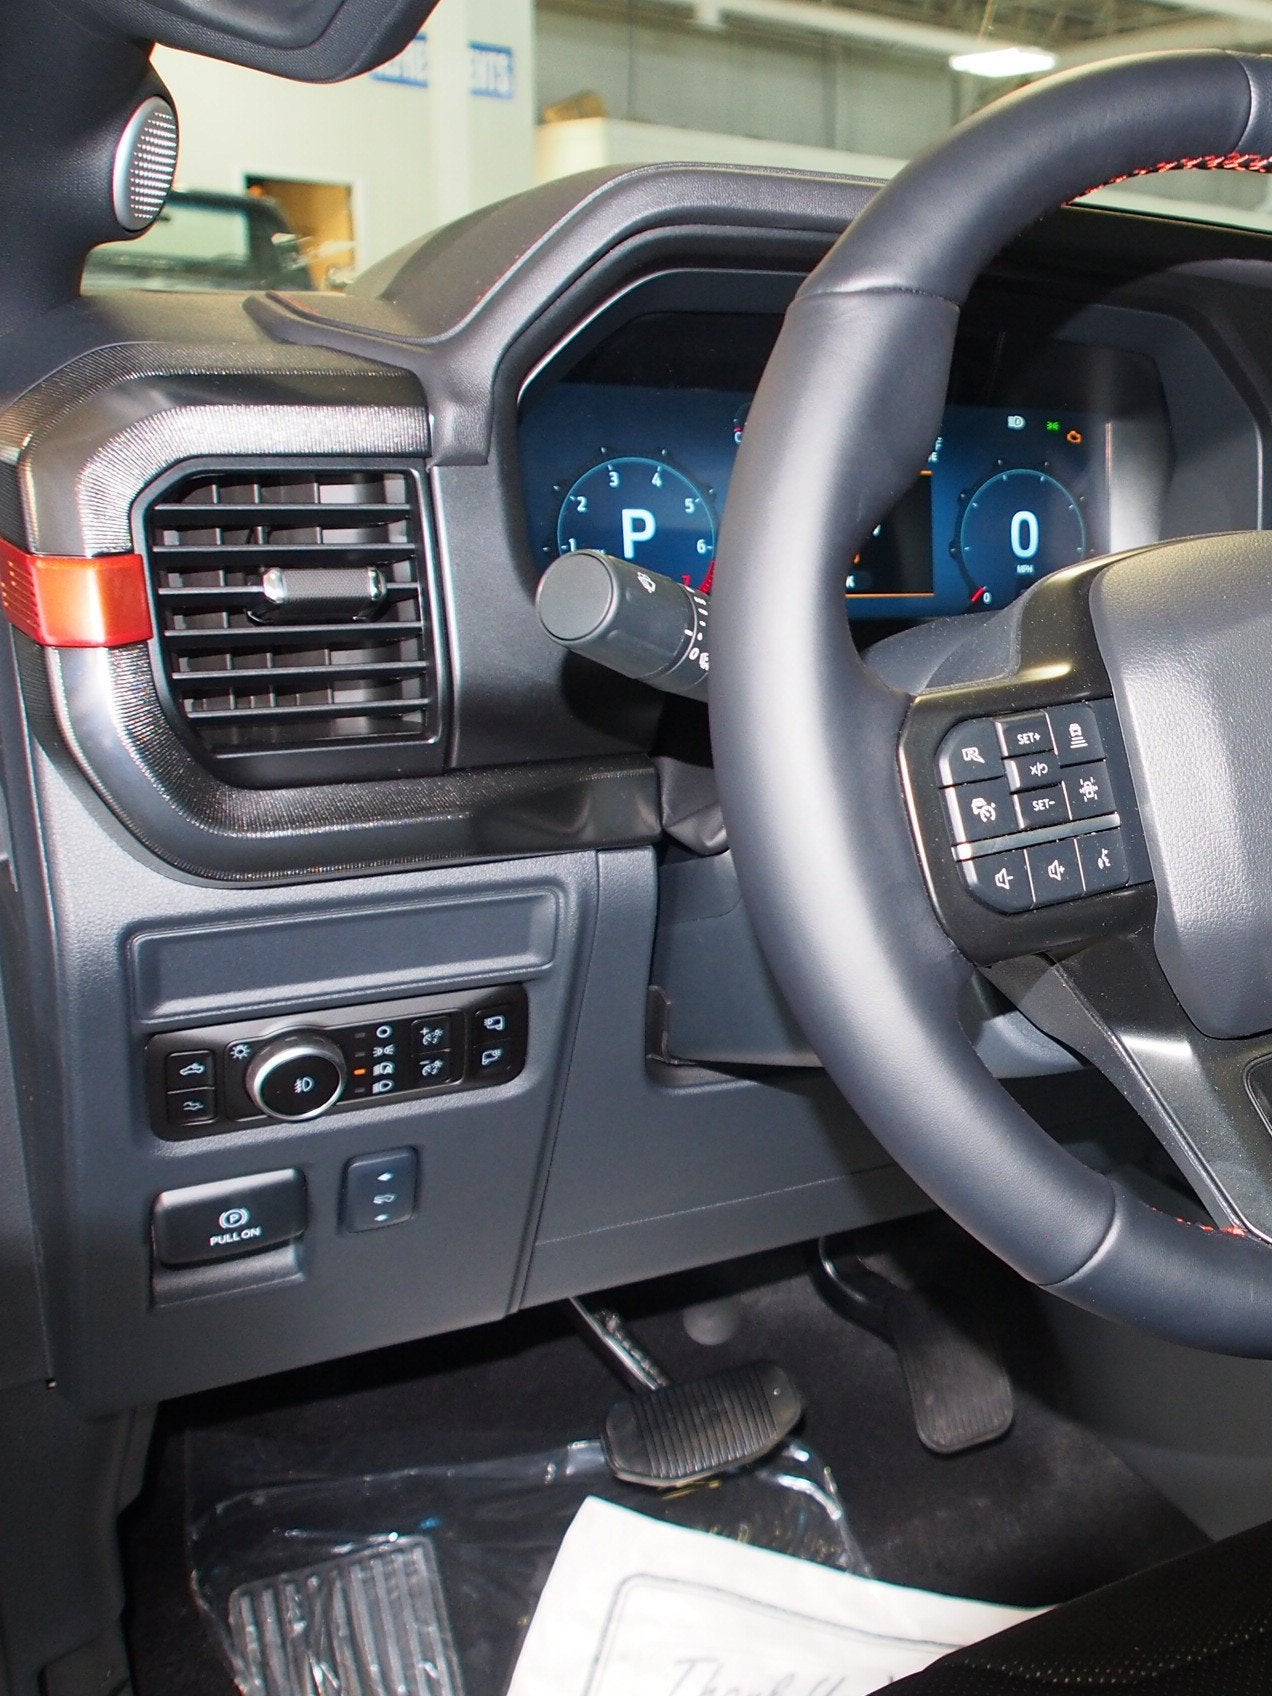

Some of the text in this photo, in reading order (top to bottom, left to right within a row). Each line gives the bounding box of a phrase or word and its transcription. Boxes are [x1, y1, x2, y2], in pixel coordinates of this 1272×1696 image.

[609, 471, 620, 487] 3
[651, 473, 663, 488] 4
[576, 496, 588, 512] 2
[684, 498, 696, 513] 5
[621, 508, 656, 560] P
[1010, 510, 1039, 559] 0
[696, 538, 707, 554] 6
[1016, 731, 1041, 746] SET+
[1032, 798, 1056, 812] SET-
[210, 1226, 261, 1246] PULL ON
